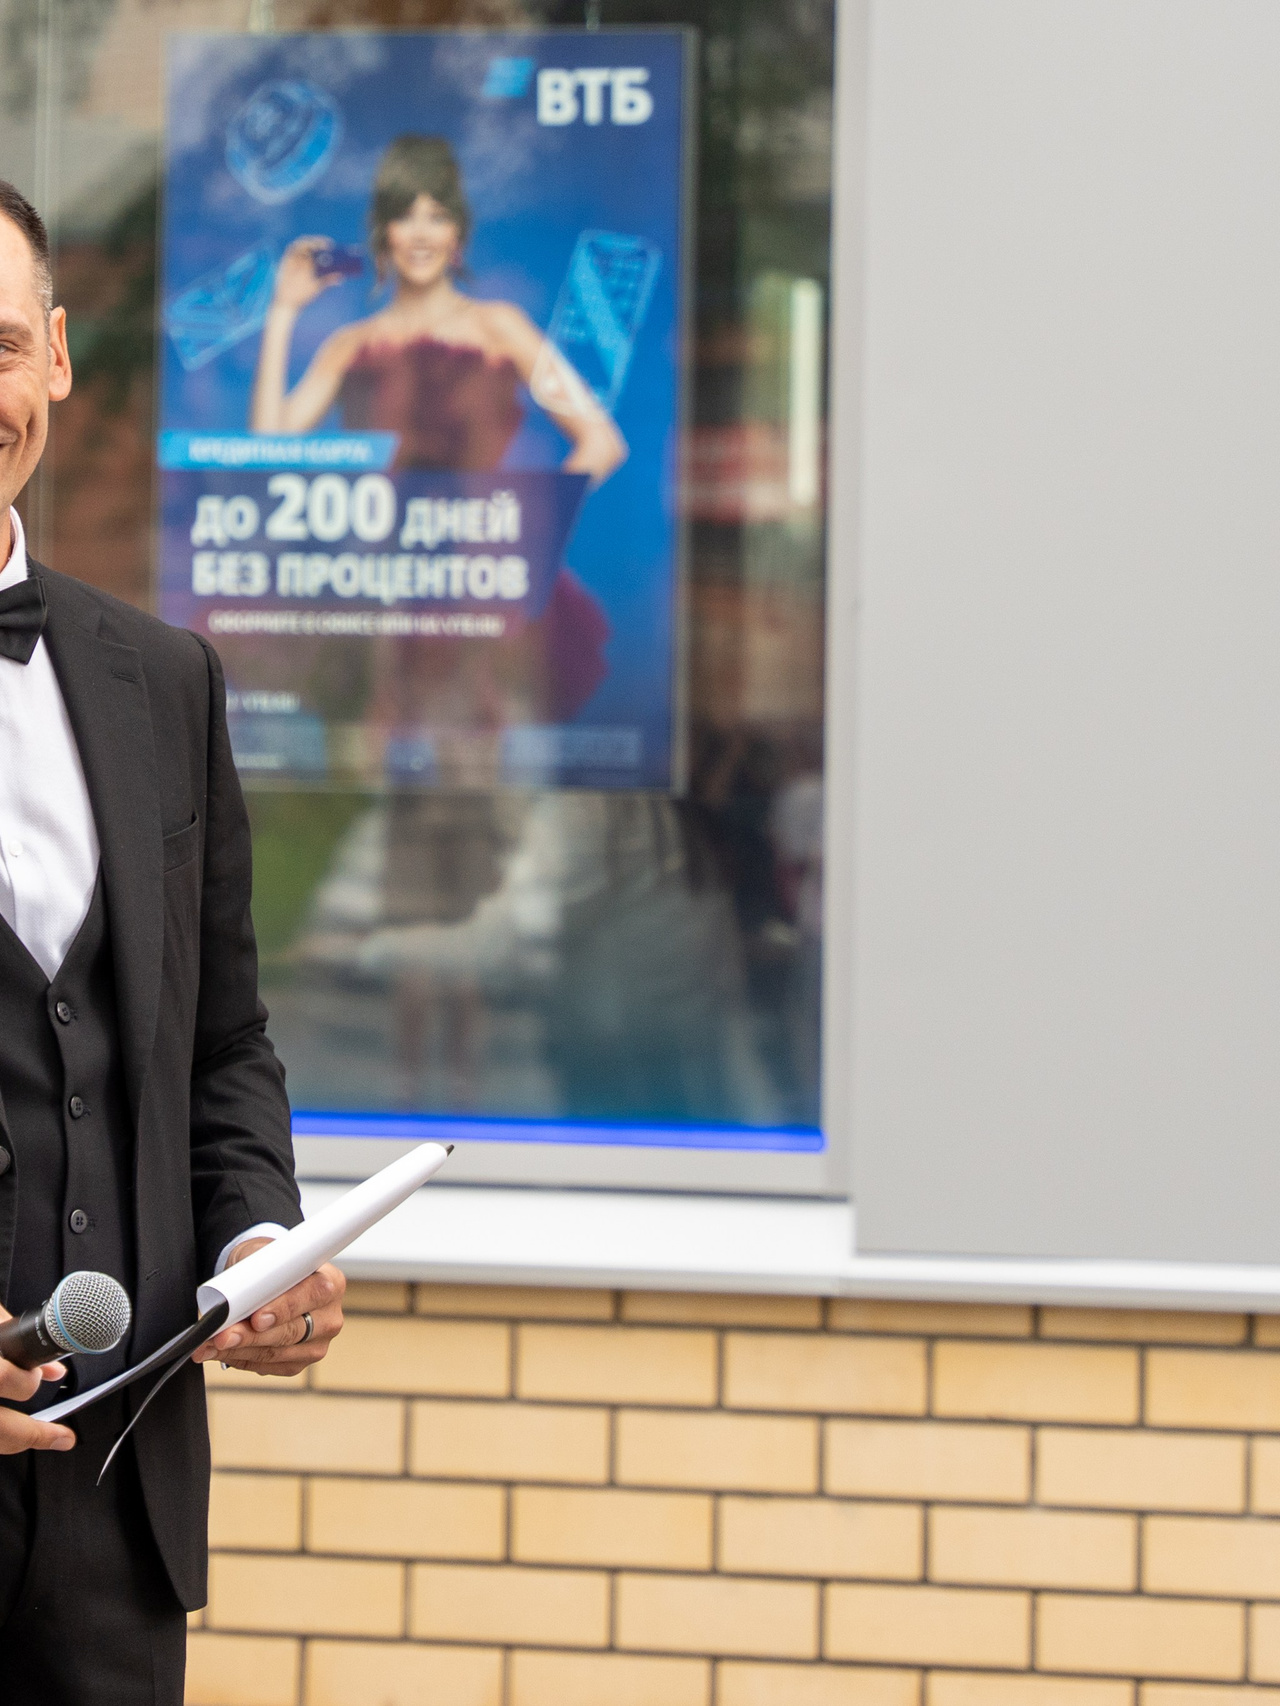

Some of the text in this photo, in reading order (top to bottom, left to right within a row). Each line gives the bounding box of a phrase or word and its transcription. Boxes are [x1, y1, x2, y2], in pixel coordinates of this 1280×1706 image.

[537, 67, 654, 127] ВТБ
[266, 472, 397, 543] 200
[400, 488, 521, 550] ДНЕЙ
[191, 551, 529, 604] БЕЗ ПРОЦЕНТОВ
